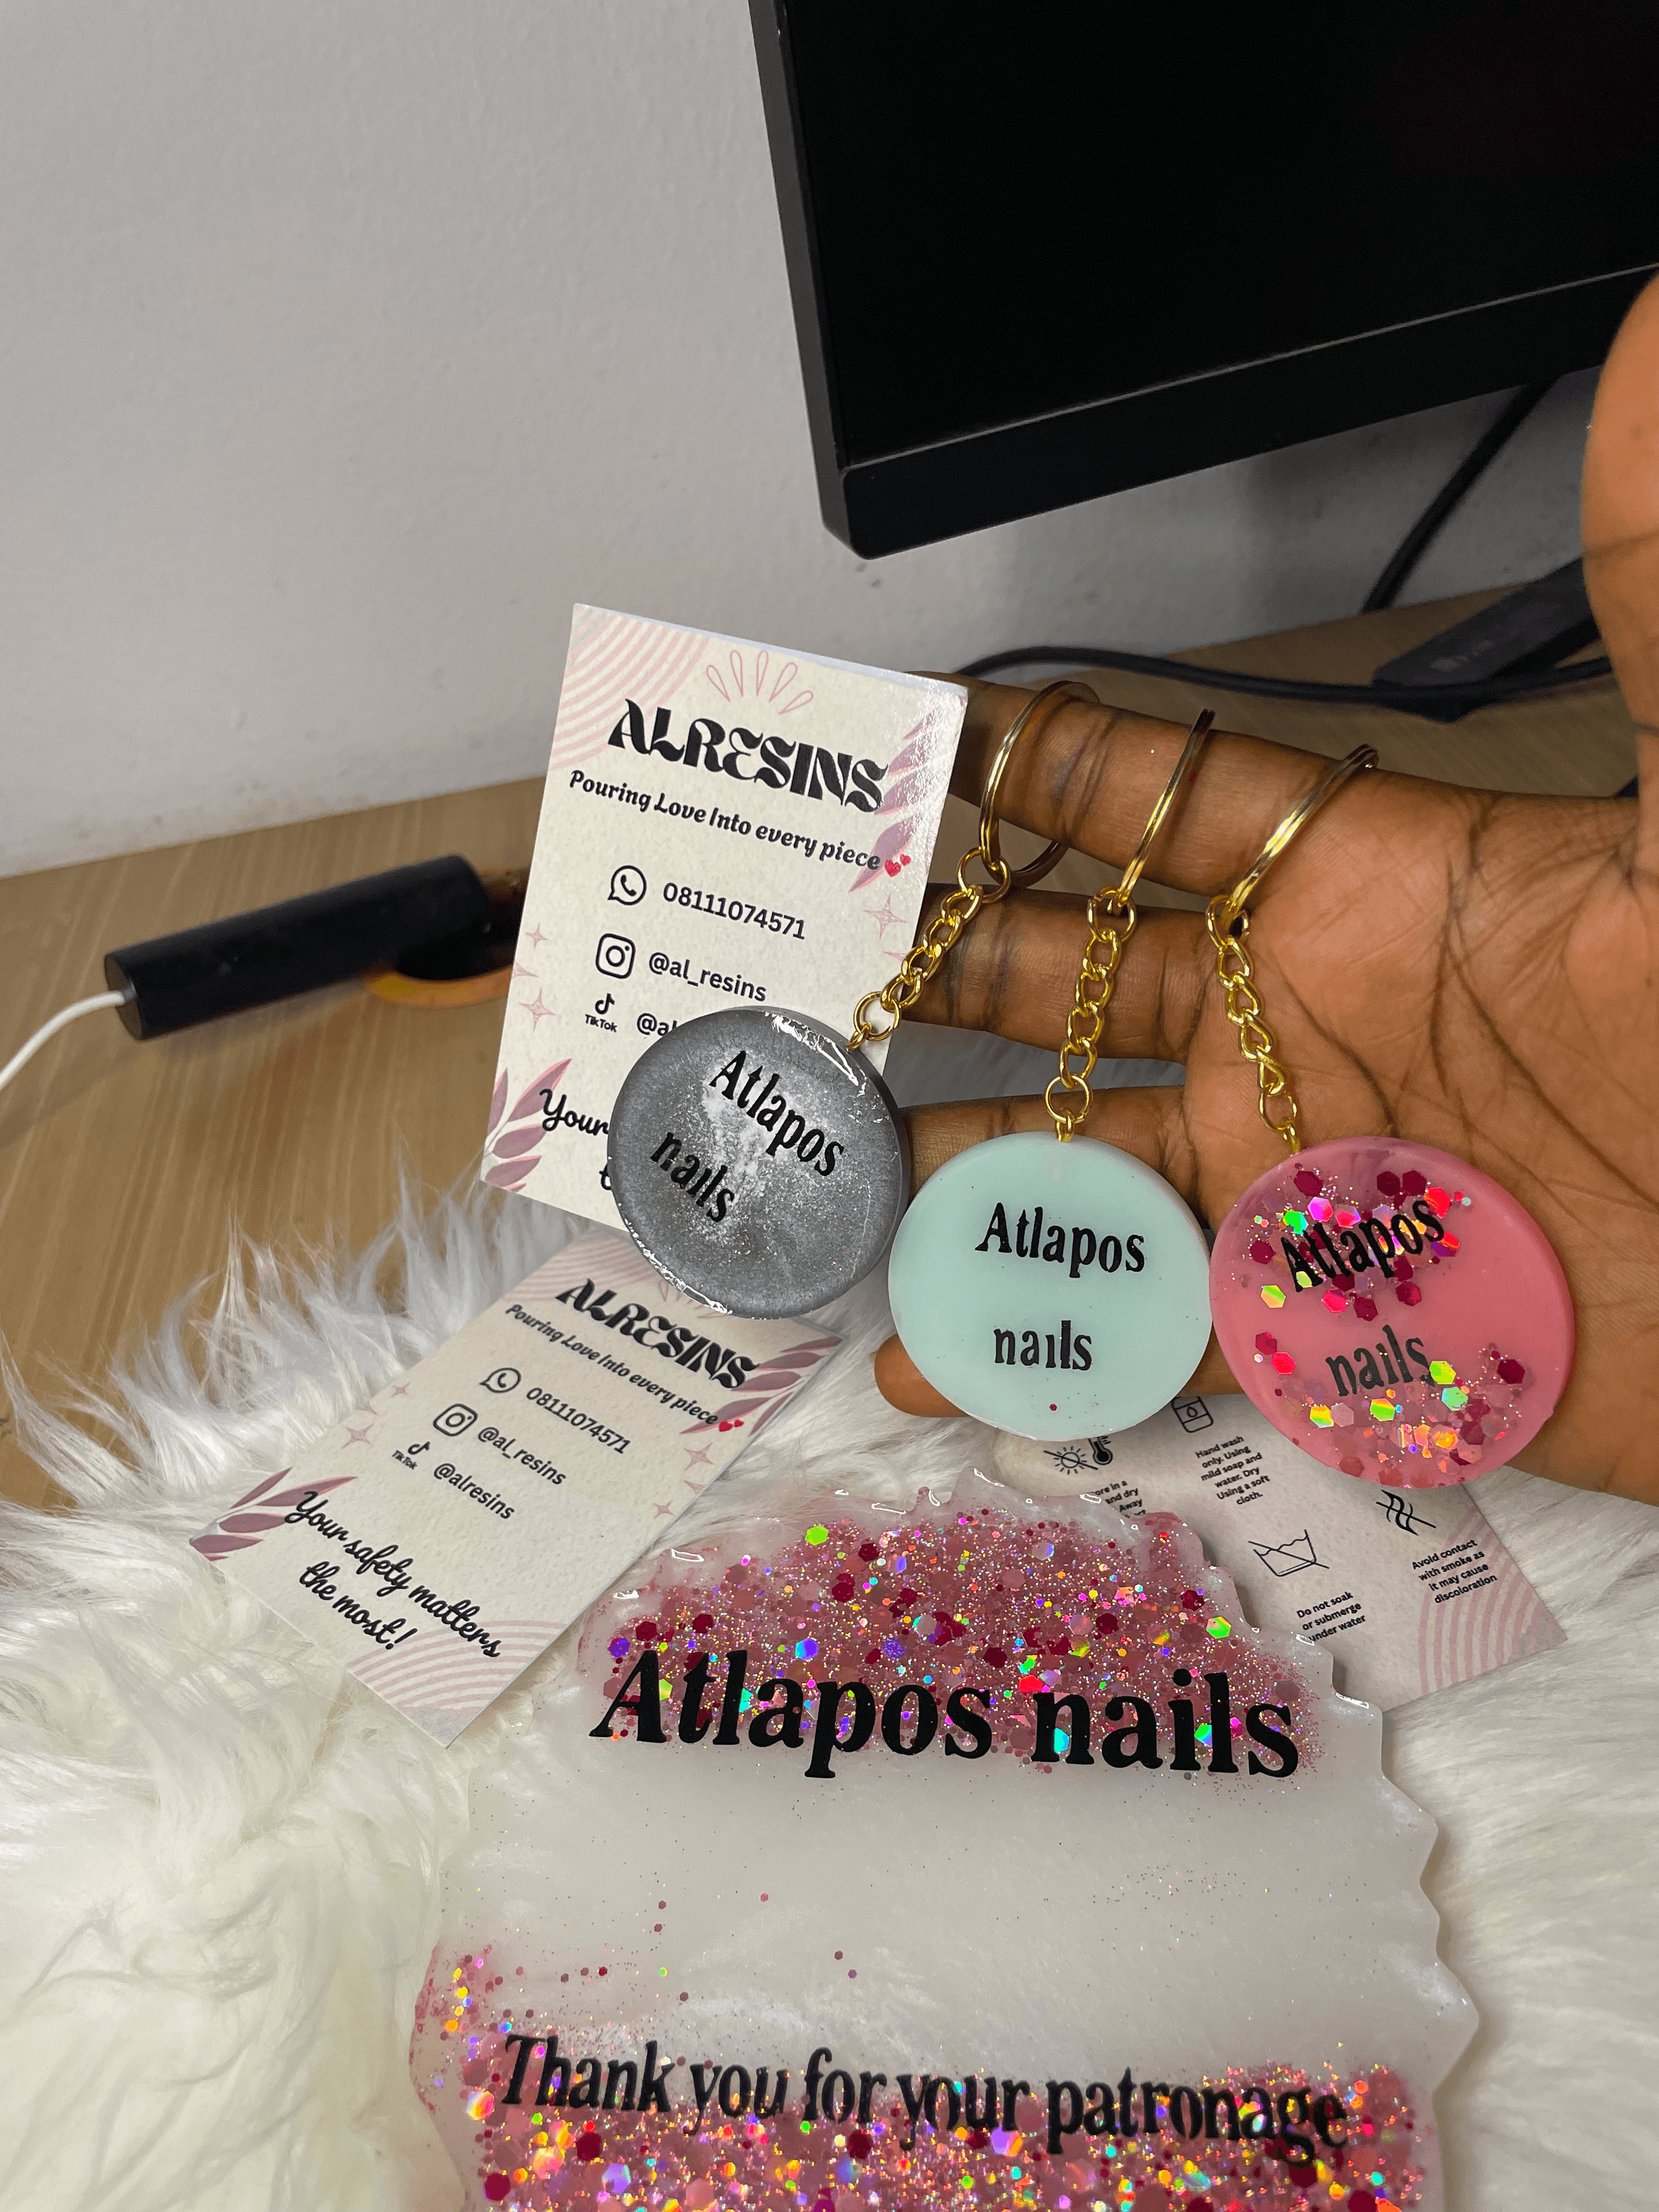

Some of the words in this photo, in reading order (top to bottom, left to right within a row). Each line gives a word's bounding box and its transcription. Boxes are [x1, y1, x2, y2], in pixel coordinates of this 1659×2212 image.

[607, 699, 888, 813] ALRESINS
[569, 770, 651, 812] Pouring
[654, 793, 706, 822] Love
[709, 808, 751, 835] Into
[756, 825, 817, 858] every
[820, 841, 880, 870] piece
[663, 882, 805, 940] 08111074571
[648, 952, 767, 1001] @al_resins
[585, 1014, 618, 1033] TikTok
[539, 1089, 609, 1136] Your
[709, 1050, 845, 1177] Atlapos
[650, 1131, 736, 1223] nails
[975, 1202, 1145, 1278] Atlapos
[1281, 1200, 1445, 1293] Atlapos
[556, 1278, 760, 1389] ALRESINS
[994, 1320, 1092, 1371] nails
[505, 1304, 564, 1342] Pouring
[561, 1335, 601, 1360] Love
[597, 1354, 630, 1377] Into
[629, 1374, 676, 1404] every
[670, 1400, 719, 1424] piece
[1325, 1325, 1436, 1397] nails
[527, 1387, 631, 1454] 08111074571
[392, 1450, 417, 1470] TikTok
[478, 1427, 566, 1484] @al_resins
[1195, 1444, 1220, 1458] Hand
[1221, 1436, 1244, 1448] wash
[1201, 1468, 1221, 1481] mild
[1222, 1461, 1244, 1473] soap
[1245, 1452, 1262, 1464] and
[1202, 1457, 1224, 1468] only.
[1224, 1446, 1251, 1459] Using
[434, 1463, 515, 1519] @alresins
[1095, 1487, 1110, 1496] ore
[1124, 1488, 1138, 1497] dry
[1214, 1474, 1243, 1487] water.
[1243, 1467, 1259, 1477] Dry
[1217, 1486, 1245, 1499] Using
[1251, 1475, 1270, 1487] soft
[1236, 1492, 1263, 1505] cloth.
[1119, 1499, 1142, 1512] Away
[284, 1491, 347, 1541] Your
[343, 1539, 413, 1597] safety
[408, 1585, 502, 1657] matters
[1412, 1553, 1439, 1570] Avoid
[1440, 1540, 1478, 1558] contact
[1418, 1568, 1441, 1581] with
[1441, 1557, 1472, 1572] smoke
[1473, 1551, 1485, 1560] as
[1439, 1575, 1459, 1587] may
[1461, 1564, 1488, 1579] cause
[299, 1561, 340, 1600] the
[332, 1595, 418, 1650] most!
[1297, 1609, 1312, 1618] Do
[1313, 1601, 1330, 1612] not
[1331, 1592, 1353, 1605] soak
[1434, 1575, 1497, 1603] discoloration
[1302, 1621, 1313, 1630] or
[1315, 1603, 1361, 1625] submerge
[1308, 1627, 1337, 1641] under
[1338, 1615, 1366, 1630] water
[588, 1649, 991, 1778] Atlapos
[1031, 1668, 1299, 1777] nails
[502, 2034, 676, 2112] Thank
[683, 2063, 788, 2136] you
[803, 2047, 887, 2124] for
[896, 2073, 1031, 2151] your
[1046, 2066, 1348, 2167] patronage
